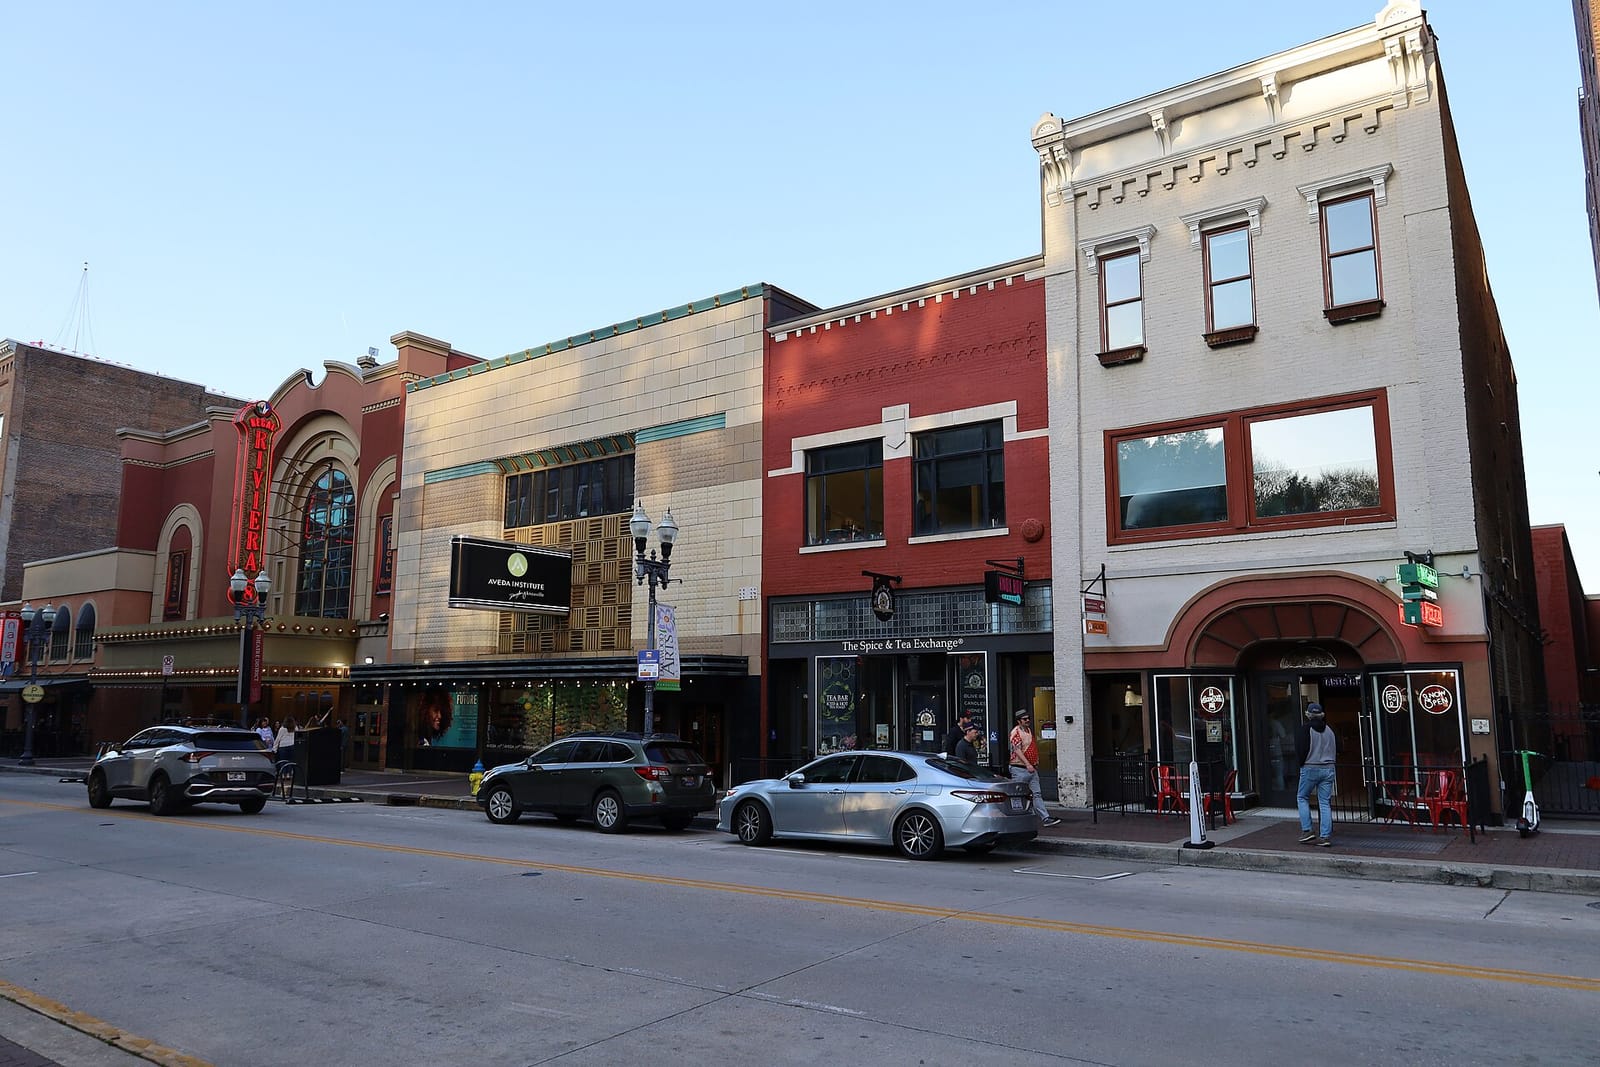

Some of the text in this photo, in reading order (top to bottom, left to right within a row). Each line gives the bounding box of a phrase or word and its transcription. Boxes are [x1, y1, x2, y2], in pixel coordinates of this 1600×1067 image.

[249, 417, 276, 431] REGAL
[245, 430, 267, 572] RIVIERA
[488, 578, 545, 590] AVEDA INSTITUTE
[7, 621, 16, 659] nama
[841, 641, 859, 651] The
[859, 640, 883, 653] Spice
[885, 640, 893, 649] &
[894, 639, 912, 649] Tea
[662, 635, 675, 676] ARTS
[456, 694, 478, 705] FUTURE
[826, 694, 837, 702] TEA
[1428, 690, 1446, 699] NOW
